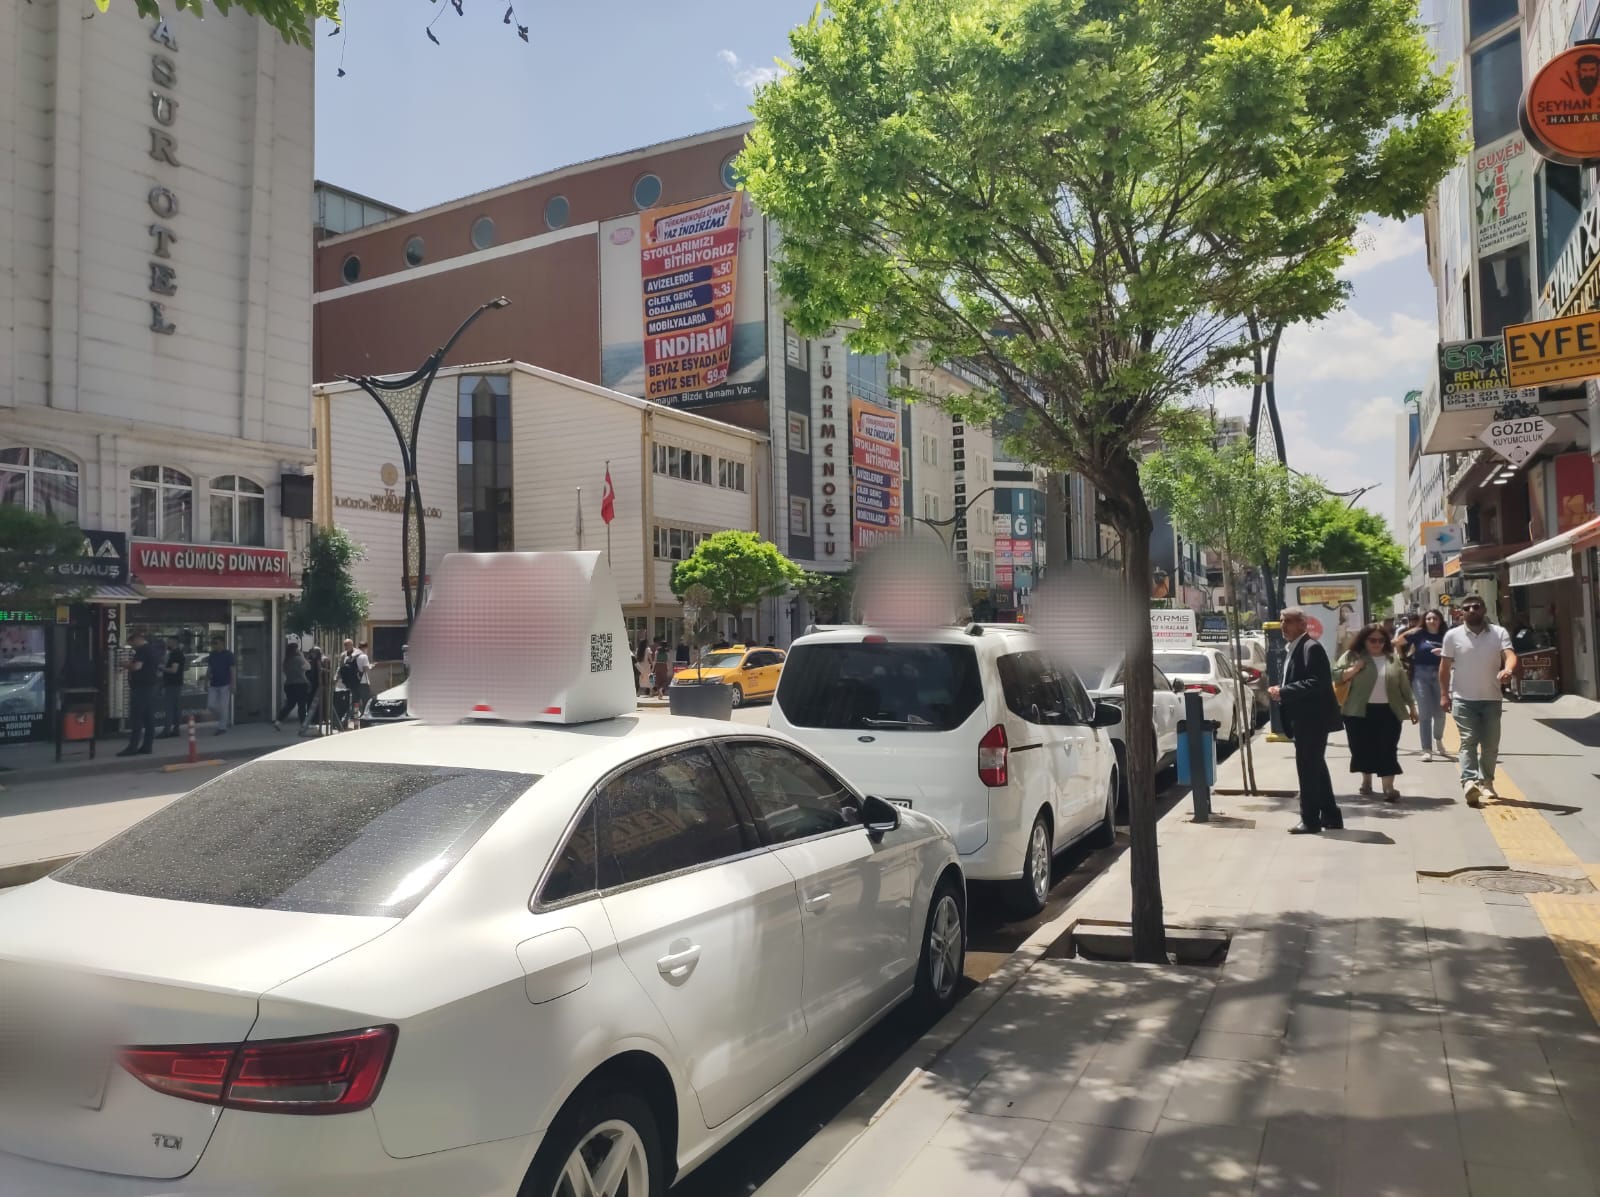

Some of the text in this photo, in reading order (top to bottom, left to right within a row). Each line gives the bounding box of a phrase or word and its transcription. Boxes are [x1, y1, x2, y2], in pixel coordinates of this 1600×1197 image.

[1537, 98, 1591, 112] SEYHAN
[1550, 114, 1580, 124] HAIR
[147, 15, 180, 336] ASUR OTEL
[663, 228, 678, 240] YAZ
[679, 212, 728, 236] İNDİRİMİ
[643, 236, 714, 261] STOKLARIMIZI
[664, 243, 735, 270] BİTİRİYORUZ
[655, 326, 727, 360] İNDİRİM
[1509, 320, 1600, 362] EYFE
[649, 362, 679, 377] BEYAZ
[682, 356, 718, 374] EŞYADA
[1454, 368, 1487, 382] RENT
[1489, 368, 1498, 378] A
[680, 373, 700, 388] SETİ
[1446, 383, 1471, 393] OTO
[1491, 420, 1544, 437] GÖZDE
[1493, 433, 1543, 446] KUYUMCULUK
[820, 345, 837, 556] TÜRKMENOĞLU
[141, 549, 286, 575] VAN GÜMÜŞ DÜNYASI
